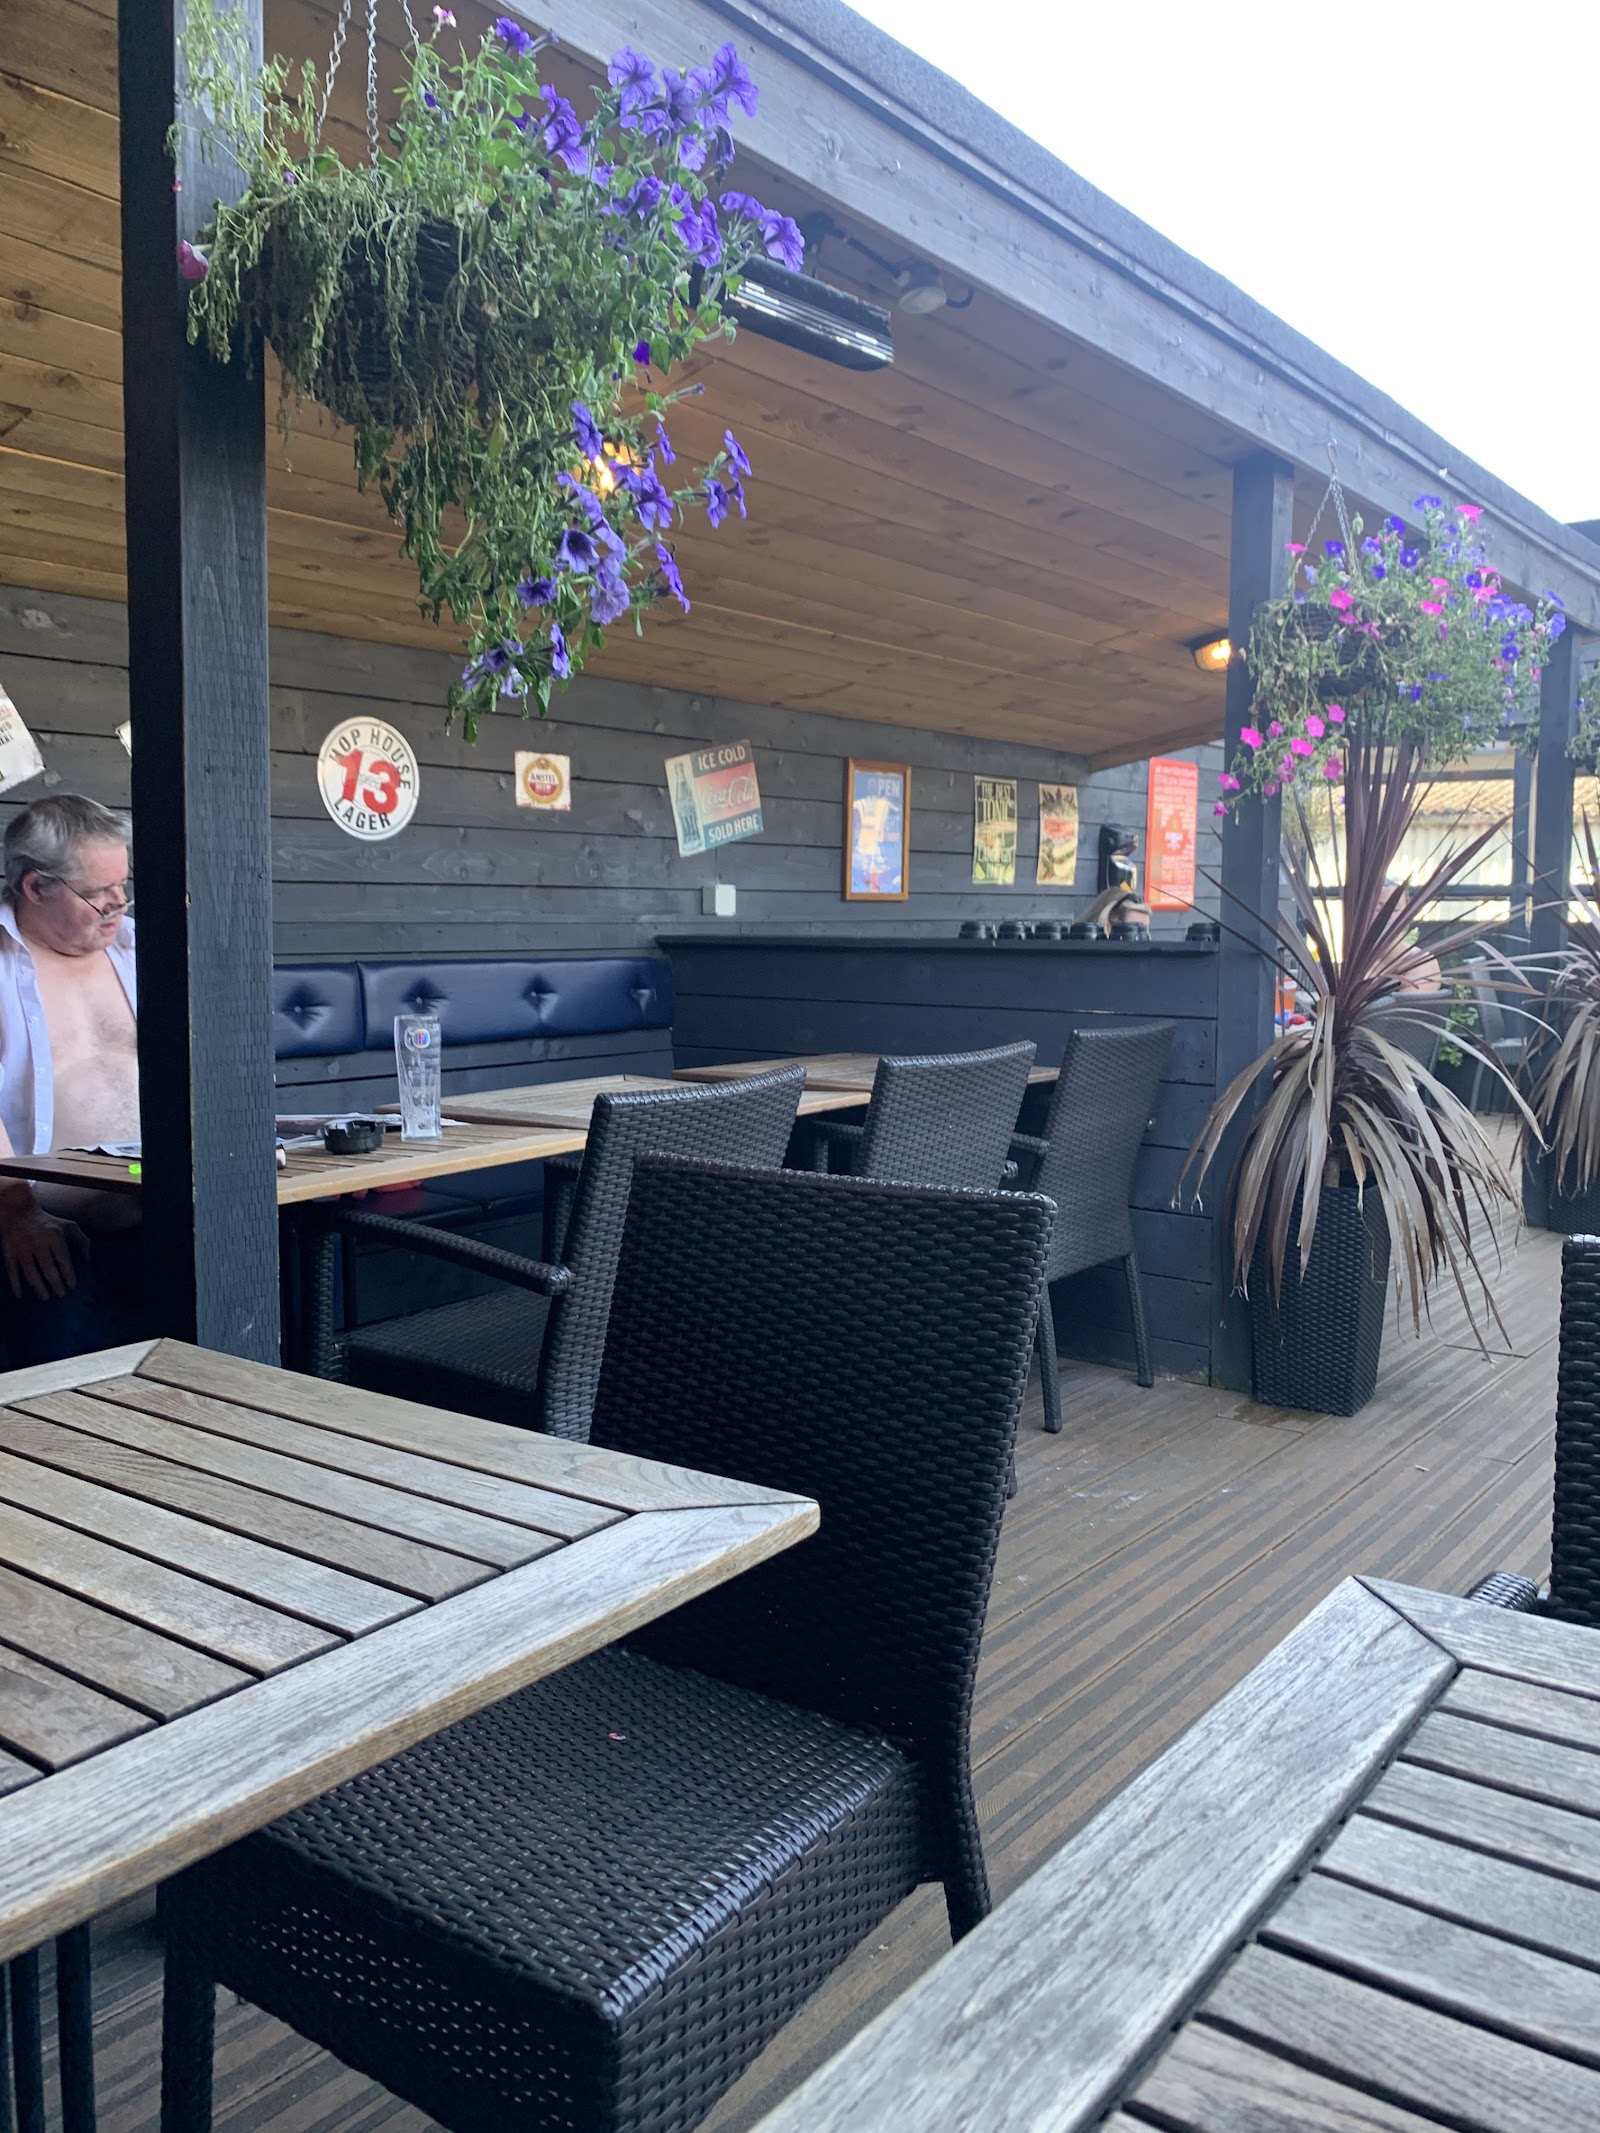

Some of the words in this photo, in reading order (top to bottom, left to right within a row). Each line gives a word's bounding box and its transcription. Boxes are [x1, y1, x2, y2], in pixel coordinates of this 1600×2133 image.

[329, 728, 361, 762] HOP
[370, 728, 411, 790] HOUSE
[698, 753, 717, 771] ICE
[718, 745, 746, 765] COLD
[338, 748, 401, 815] 13
[530, 772, 556, 783] AMSTEL
[334, 795, 391, 831] LAGER
[708, 823, 733, 843] SOLD
[734, 813, 759, 835] HERE
